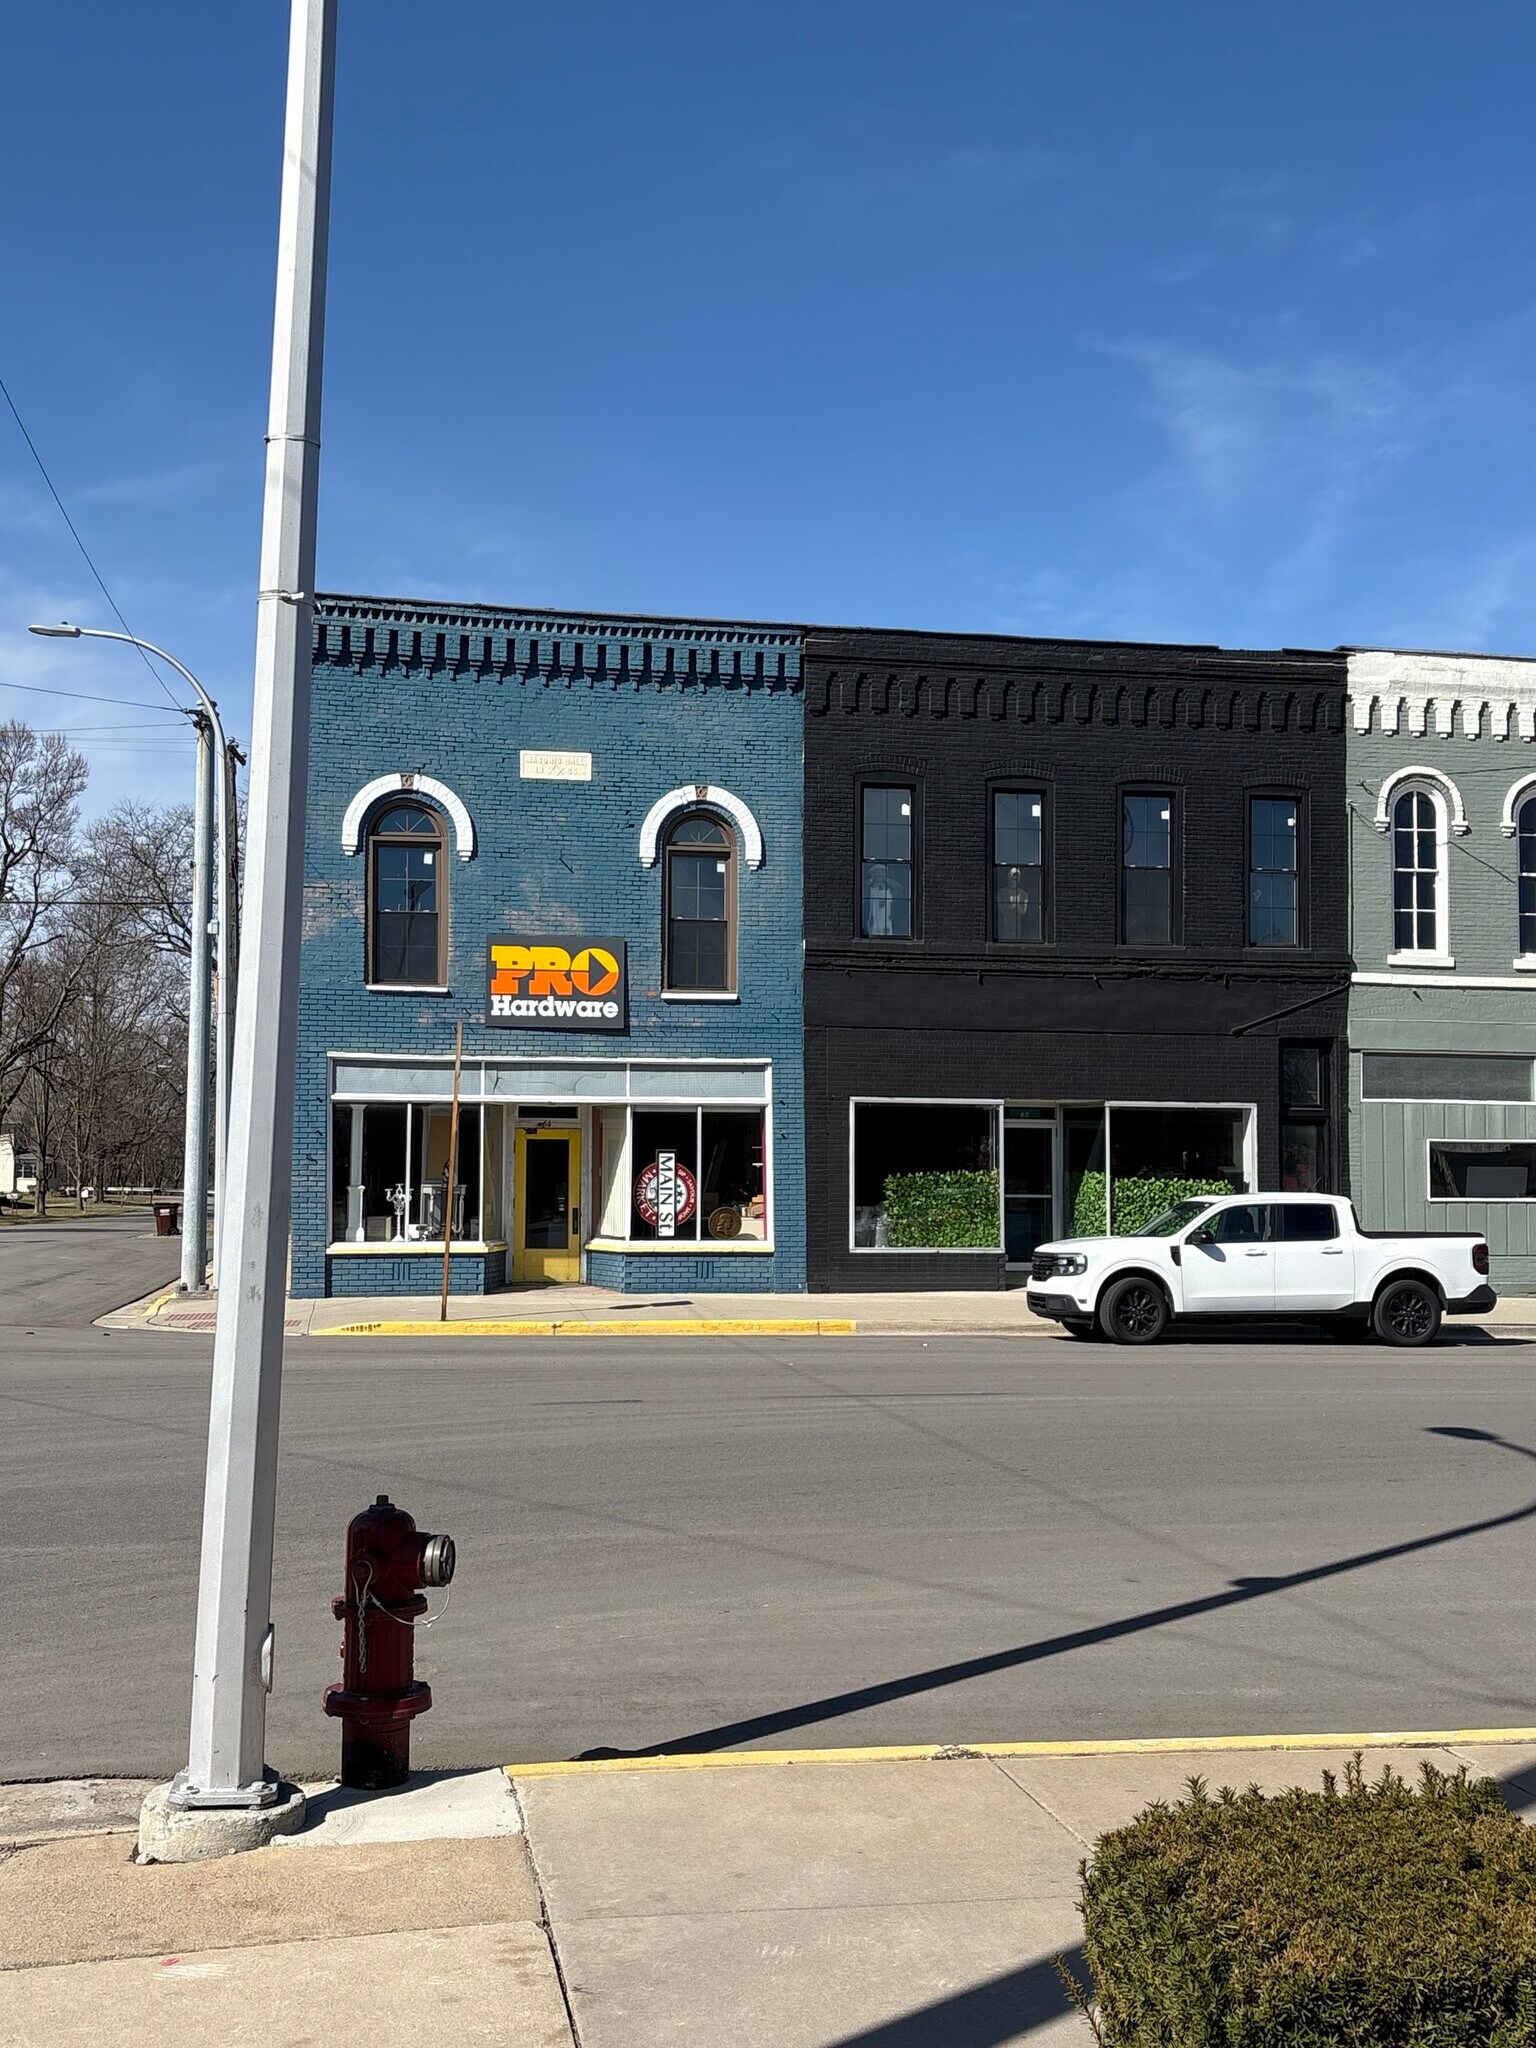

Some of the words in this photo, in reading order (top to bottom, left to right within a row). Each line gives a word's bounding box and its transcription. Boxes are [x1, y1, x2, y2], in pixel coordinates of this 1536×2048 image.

[490, 945, 619, 996] PRO
[490, 994, 619, 1018] Hardware
[635, 1171, 654, 1218] MARKET
[659, 1156, 674, 1205] MAIN
[659, 1212, 674, 1234] St.
